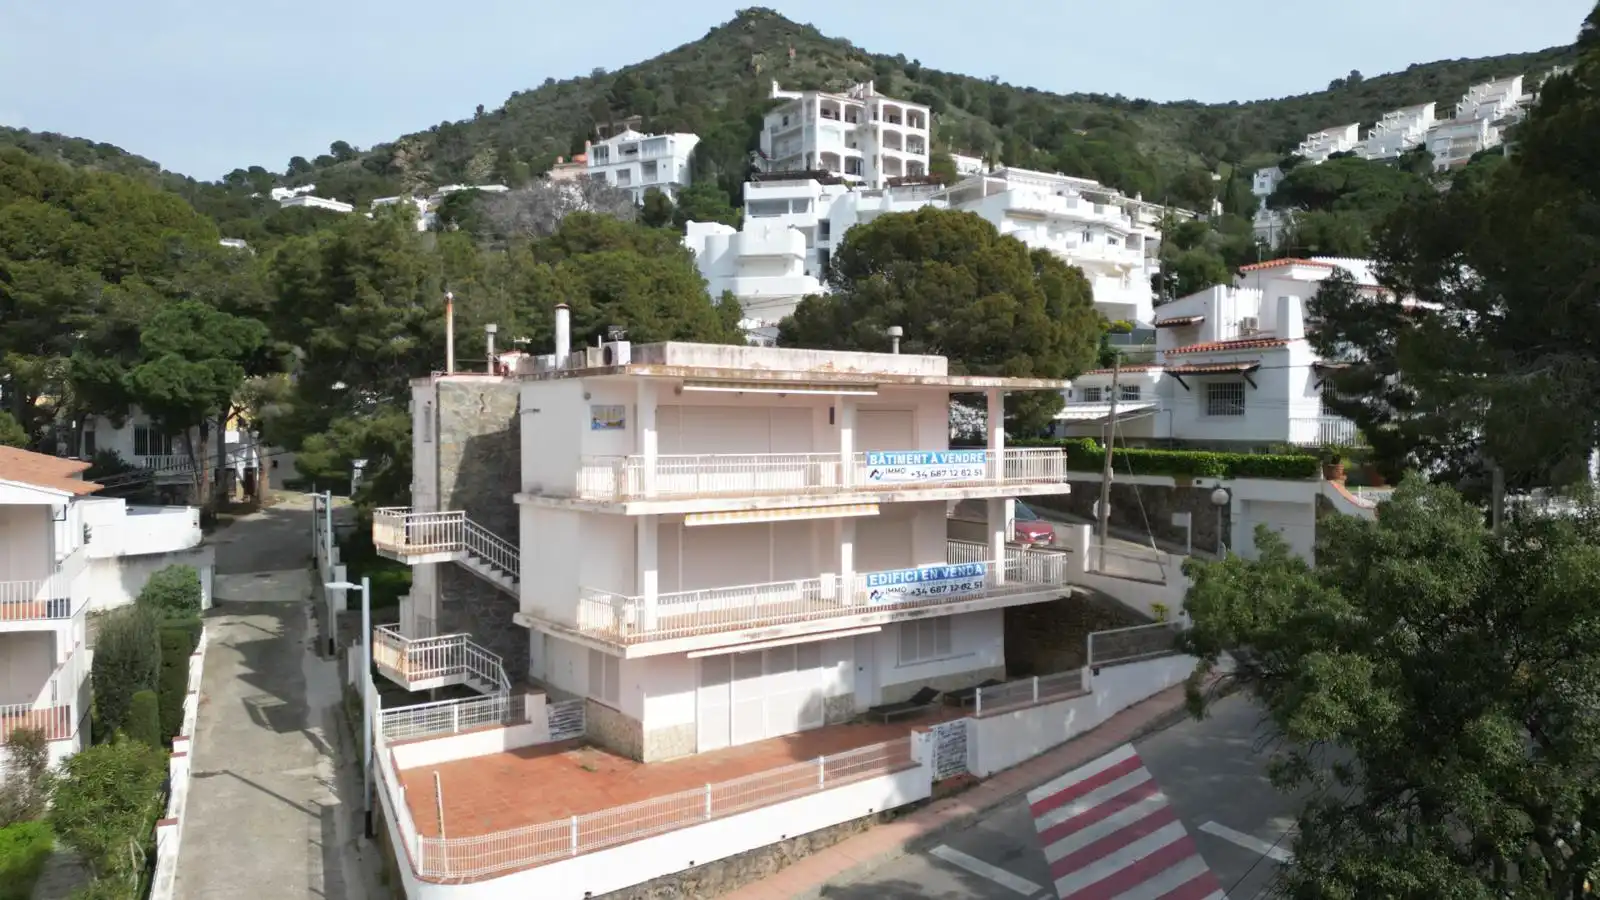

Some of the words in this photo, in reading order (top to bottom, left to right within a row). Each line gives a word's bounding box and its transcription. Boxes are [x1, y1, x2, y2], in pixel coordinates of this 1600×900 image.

[941, 452, 984, 464] VENDRE
[930, 469, 946, 477] 687
[949, 469, 959, 477] 12
[974, 468, 982, 476] 51
[869, 571, 918, 585] EDIFICI
[921, 568, 938, 580] EN
[942, 565, 982, 577] VENDA
[911, 587, 928, 596] +34
[930, 585, 947, 594] 687
[974, 581, 982, 589] 51
